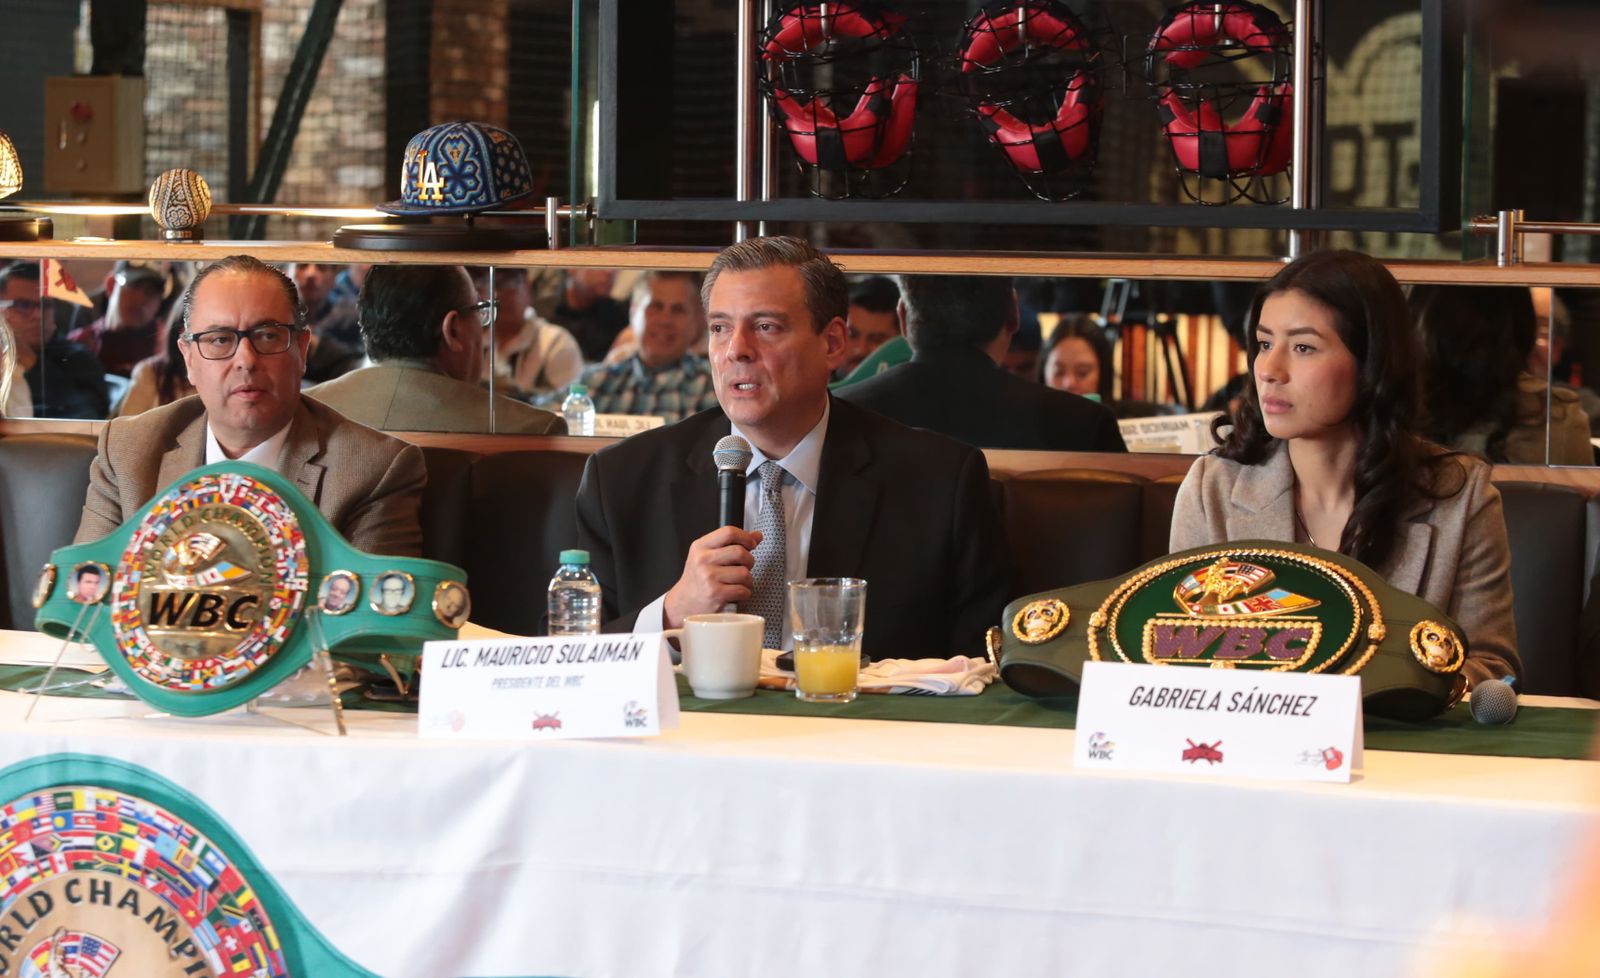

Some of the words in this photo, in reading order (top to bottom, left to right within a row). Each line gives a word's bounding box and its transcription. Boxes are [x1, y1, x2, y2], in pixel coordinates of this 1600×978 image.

[416, 150, 445, 200] LA
[142, 514, 194, 580] WORLD
[200, 507, 274, 584] CHAMPION
[149, 592, 258, 630] WBC
[441, 648, 468, 669] LIC.
[474, 645, 554, 667] MAURICIO
[557, 636, 645, 664] SULAIMÁN
[1153, 625, 1315, 660] WBC
[491, 676, 544, 690] PRESIDENTE
[546, 676, 561, 689] DEL
[564, 675, 584, 687] WBC
[1128, 686, 1221, 712] GABRIELA
[1227, 686, 1319, 717] SÁNCHEZ
[624, 717, 647, 728] WBC
[1088, 750, 1115, 762] WBC
[64, 877, 209, 978] CHAMPI
